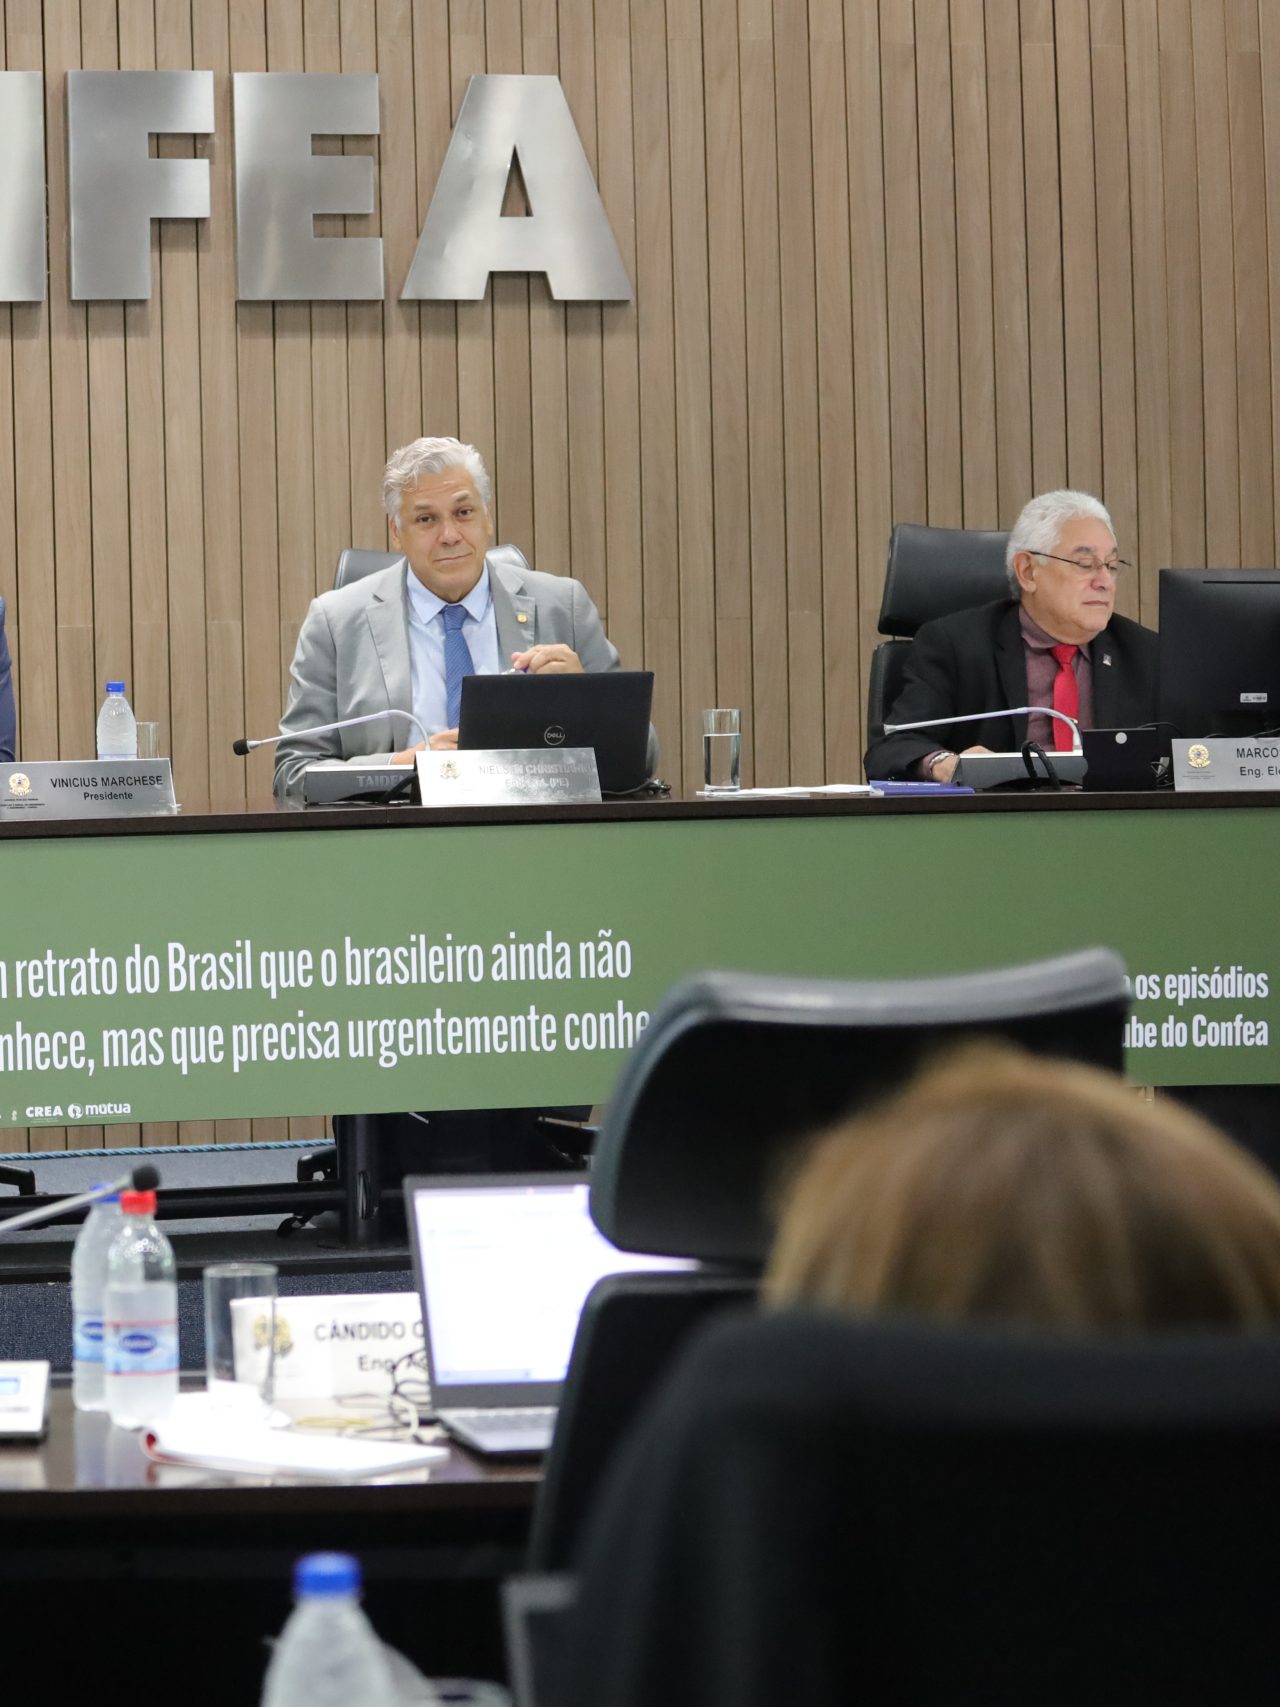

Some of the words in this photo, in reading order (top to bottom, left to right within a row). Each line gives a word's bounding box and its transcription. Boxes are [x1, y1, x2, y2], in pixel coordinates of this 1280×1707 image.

[1236, 747, 1280, 759] MARCO
[1239, 766, 1263, 778] Eng.
[50, 776, 98, 788] VINICIUS
[101, 775, 163, 787] MARCHESE
[356, 775, 404, 788] TAIDE
[83, 791, 133, 801] Presidente
[15, 947, 118, 999] retrato
[125, 943, 160, 995] do
[167, 939, 253, 993] Brasil
[259, 949, 314, 1000] que
[320, 948, 338, 987] o
[344, 934, 484, 986] brasileiro
[491, 930, 572, 982] ainda
[579, 928, 632, 979] não
[1135, 974, 1161, 1000] os
[1164, 965, 1269, 1006] episódios
[1161, 1014, 1188, 1048] do
[1192, 1013, 1268, 1048] Confea
[102, 1027, 165, 1068] mas
[170, 1024, 225, 1076] que
[232, 1009, 341, 1073] precisa
[347, 1005, 557, 1068] urgentemente
[564, 999, 650, 1051] conhe
[25, 1105, 64, 1118] CREA
[314, 1319, 405, 1341] CÂNDIDO
